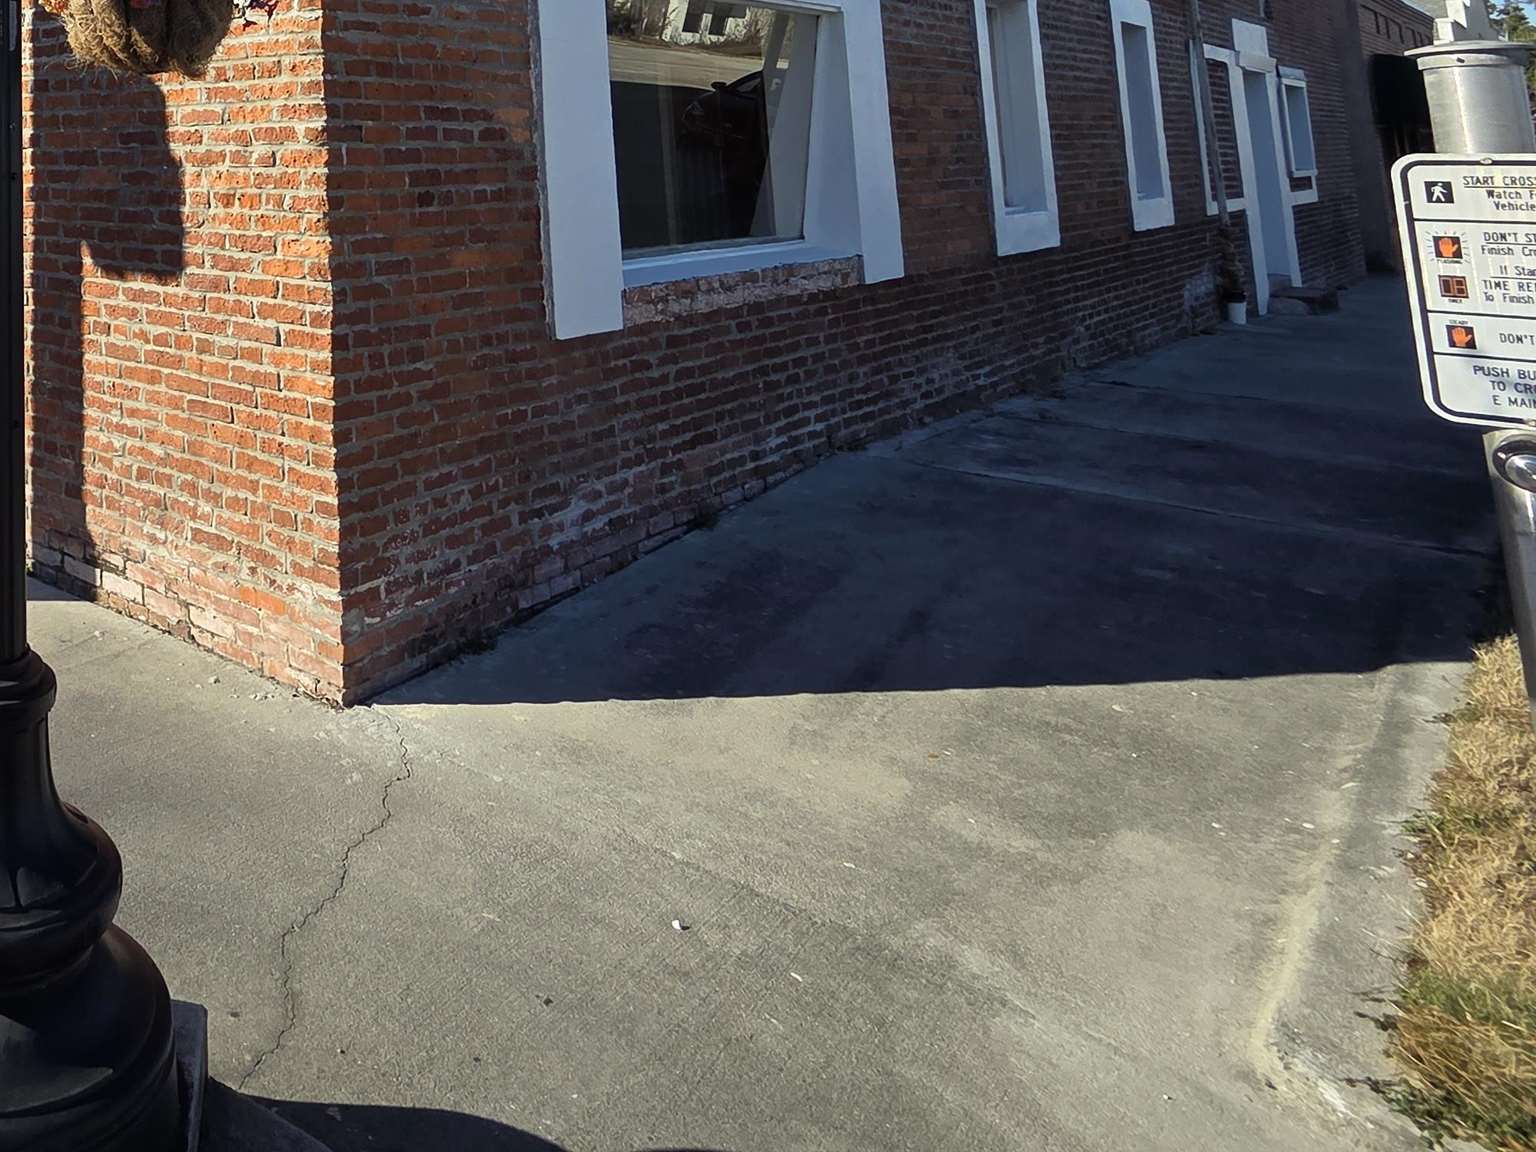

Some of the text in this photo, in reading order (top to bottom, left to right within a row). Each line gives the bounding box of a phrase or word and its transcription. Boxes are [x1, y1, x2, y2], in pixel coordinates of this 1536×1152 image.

[1463, 175, 1536, 186] START CROS
[1486, 189, 1522, 200] Watch
[1483, 232, 1519, 242] DON'T
[1481, 245, 1514, 256] Finish
[1483, 279, 1510, 291] TIME
[1484, 292, 1535, 305] To Finish
[1499, 333, 1536, 345] DON'T
[1473, 365, 1536, 381] PUSH BU
[1489, 380, 1506, 392] TO
[1492, 395, 1501, 405] E
